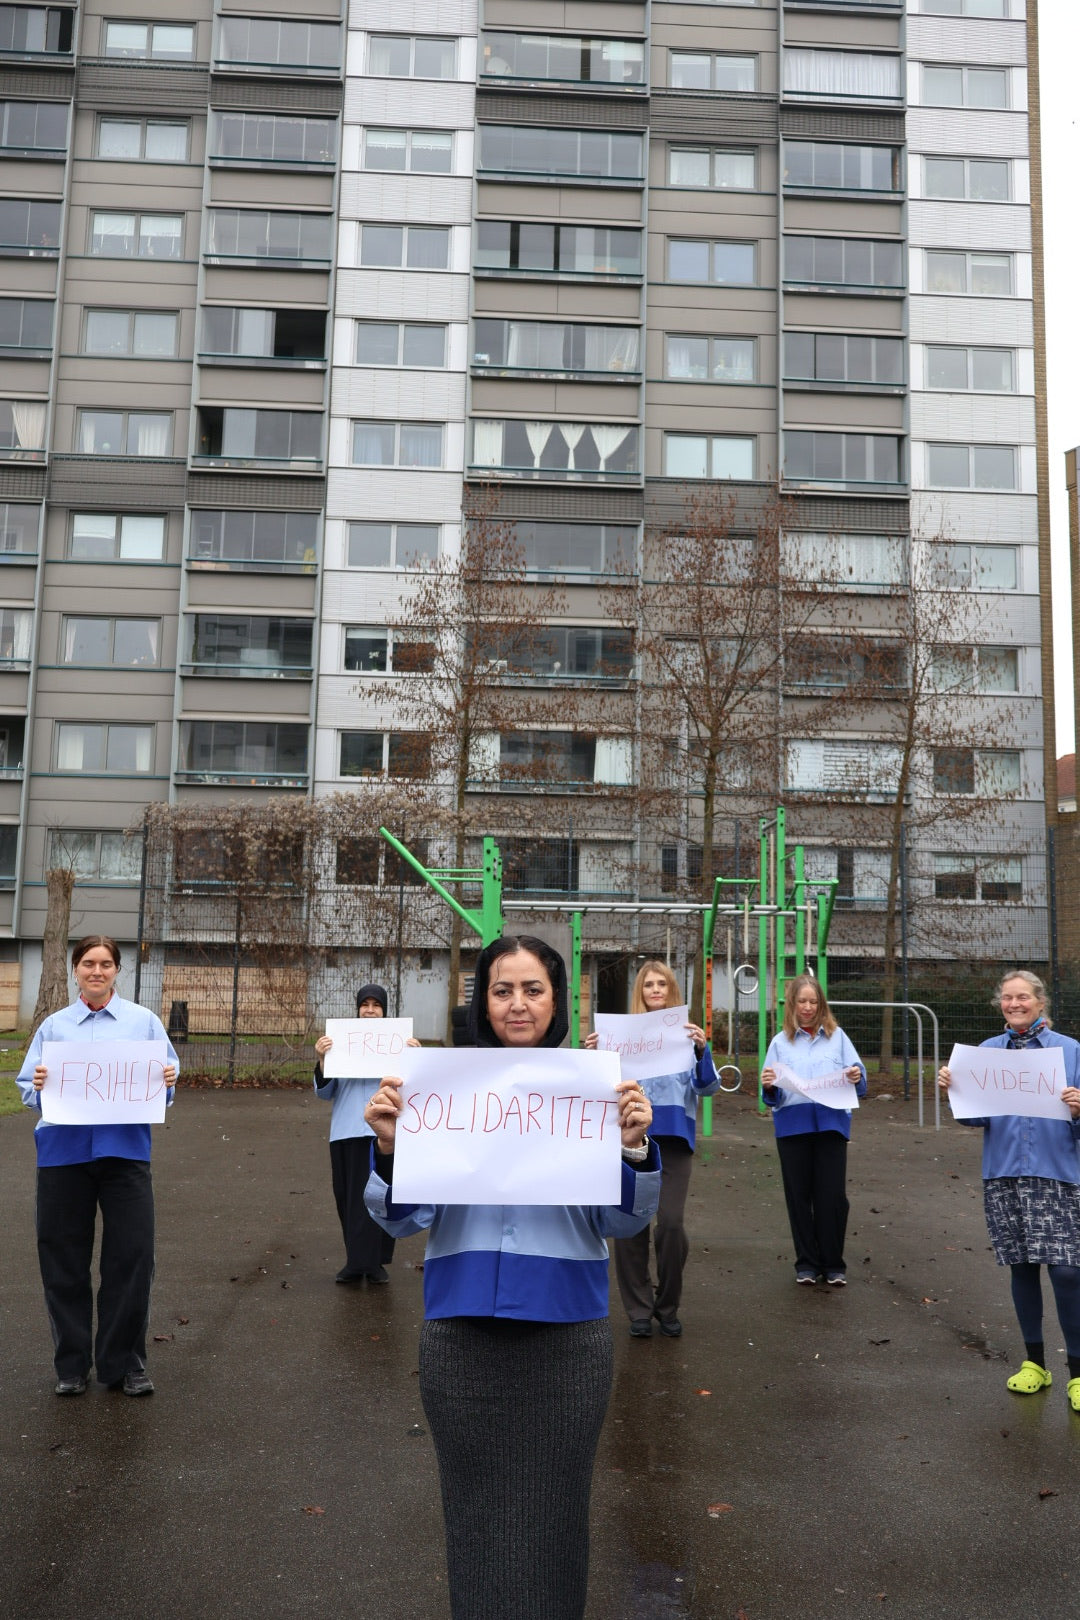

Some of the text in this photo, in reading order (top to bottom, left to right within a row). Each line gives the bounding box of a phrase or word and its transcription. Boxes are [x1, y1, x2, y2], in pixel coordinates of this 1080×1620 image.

[347, 1031, 404, 1056] FRED
[60, 1059, 166, 1102] FRIHED
[969, 1067, 1057, 1096] VIDEN
[402, 1091, 618, 1141] SOLIDARITET
